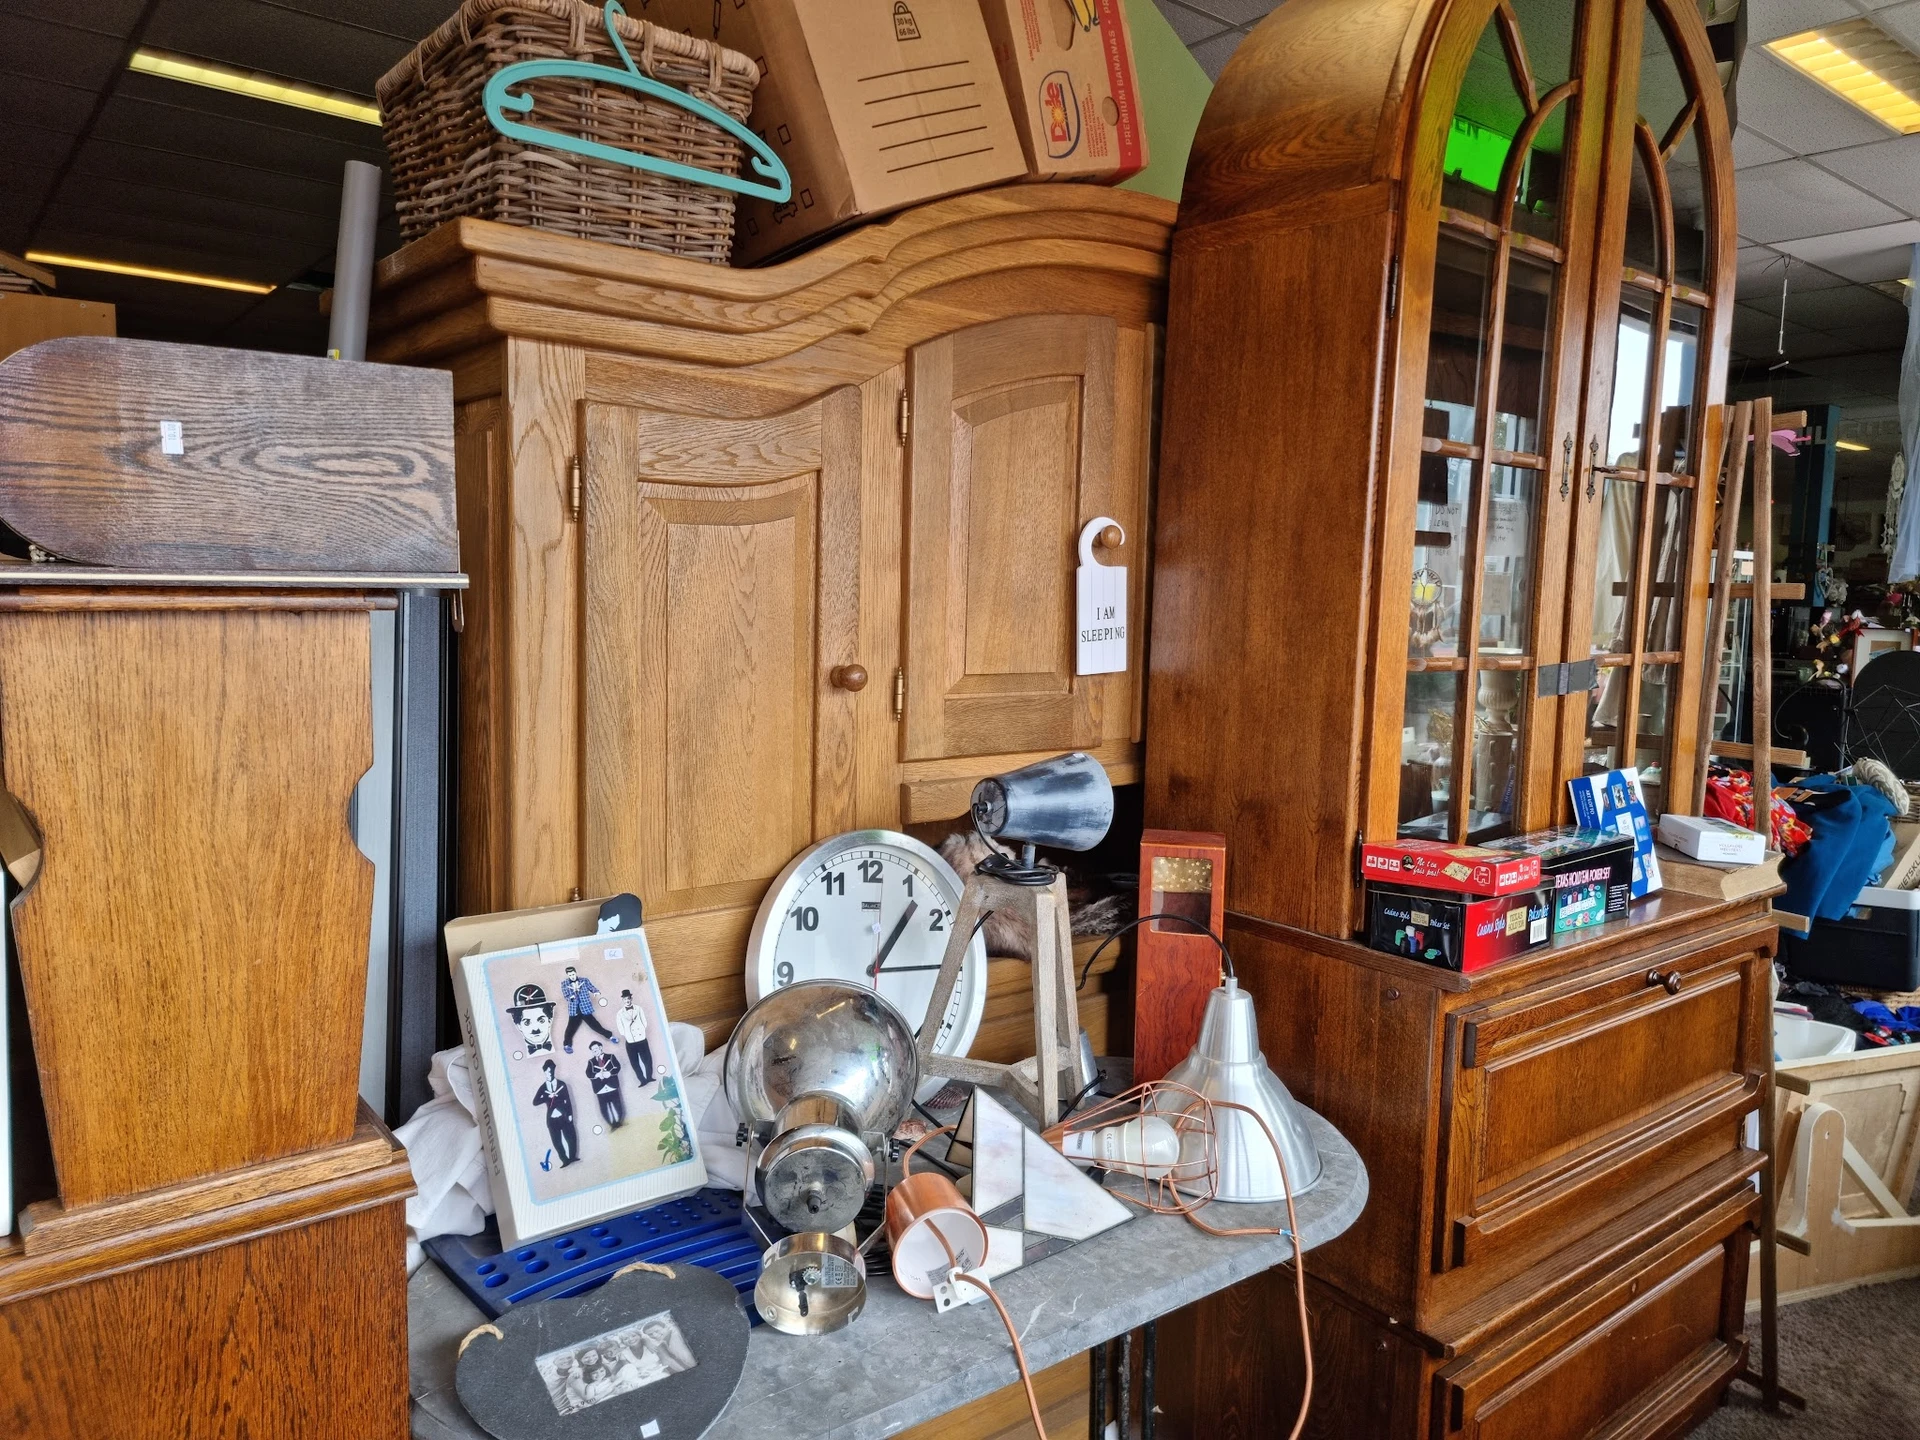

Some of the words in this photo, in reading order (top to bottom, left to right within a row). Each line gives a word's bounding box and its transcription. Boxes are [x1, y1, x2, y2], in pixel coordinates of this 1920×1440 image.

[1108, 30, 1124, 86] BANANAS
[1044, 82, 1067, 142] Dole
[1118, 90, 1132, 146] PREMIUM
[1096, 608, 1100, 620] I
[1103, 606, 1115, 620] AM
[1081, 626, 1125, 642] SLEEPING
[821, 872, 845, 896] 11
[858, 860, 884, 884] 12
[1555, 872, 1569, 888] TEXAS
[1590, 868, 1603, 881] POKER
[1898, 854, 1920, 890] FIETSKL
[902, 874, 914, 897] 1
[790, 906, 819, 931] 10
[929, 909, 944, 932] 2
[1384, 908, 1399, 918] Casino
[1399, 911, 1410, 922] Style
[1430, 918, 1442, 928] Poker
[1442, 922, 1450, 930] Set
[1528, 905, 1542, 922] Poker
[1542, 904, 1550, 918] Set
[1476, 921, 1494, 937] Casino
[1494, 914, 1506, 939] Style
[776, 962, 794, 986] 9
[464, 1008, 479, 1071] CLOCK
[478, 1076, 500, 1176] PENDULUM
